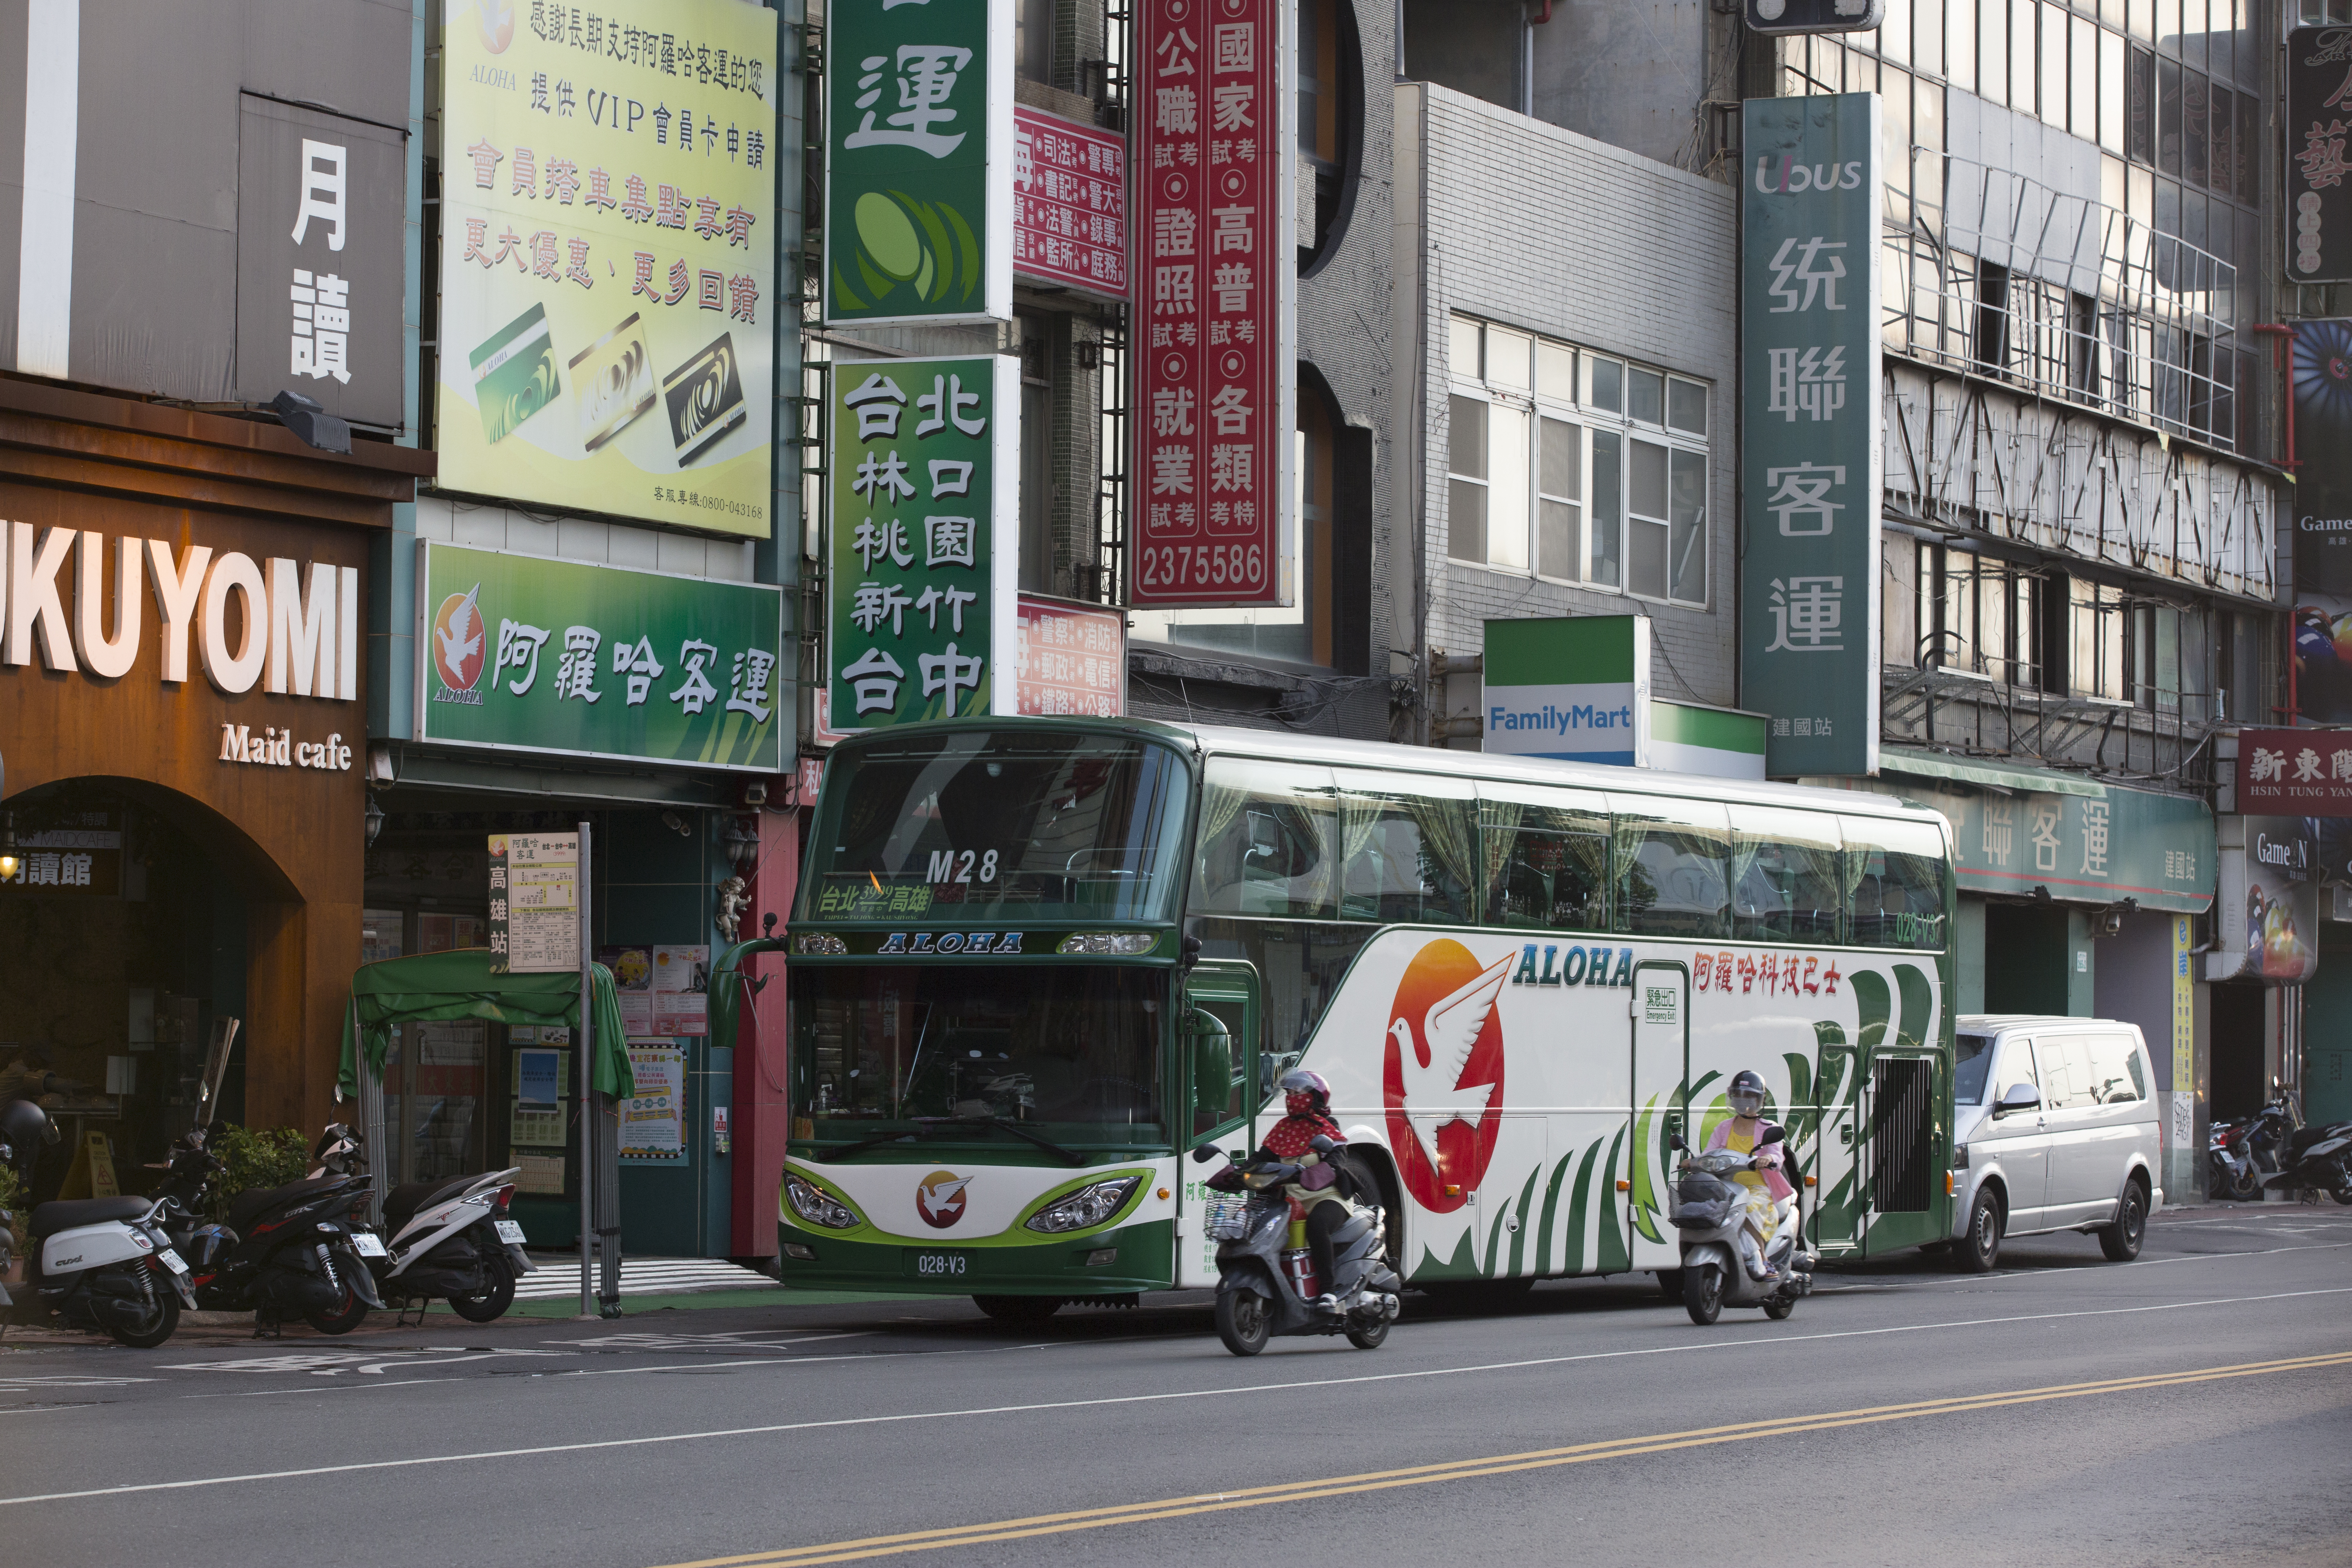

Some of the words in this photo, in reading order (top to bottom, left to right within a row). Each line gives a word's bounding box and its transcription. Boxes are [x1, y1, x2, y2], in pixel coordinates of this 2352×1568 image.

[530, 0, 763, 100] 感謝長期支持阿羅哈客運的您
[470, 65, 516, 91] ALOHA
[844, 0, 973, 158] 運
[531, 72, 575, 118] 提供
[587, 89, 644, 132] VIP
[653, 102, 765, 171] 會員卡申請
[467, 138, 755, 249] 會員搭車集點享有
[291, 138, 352, 385] 月讀
[487, 350, 508, 372] ALOHA
[639, 388, 654, 404] ALOHA
[729, 405, 745, 422] ALOHA
[844, 372, 987, 440] 台北
[1765, 236, 1847, 653] 統聯客運
[852, 450, 973, 506] 林口
[852, 516, 976, 572] 桃園
[1144, 544, 1261, 585] 2375586
[0, 519, 357, 701] KUYOMI
[851, 582, 977, 635] 新竹
[492, 618, 775, 724] 阿羅哈客運
[841, 642, 982, 718] 台中
[434, 686, 483, 706] ALOHA
[1491, 704, 1630, 735] FamilyMart
[1773, 717, 1833, 736] 建國站
[219, 722, 291, 766] Maid
[294, 733, 352, 771] cafe
[2250, 747, 2352, 783] 新東陽
[2250, 786, 2281, 796] HSIN
[2288, 787, 2323, 796] TUNG
[512, 838, 539, 848] 阿羅哈
[517, 850, 535, 860] 客運
[927, 849, 999, 884] M28
[2165, 850, 2195, 882] 建國站
[490, 866, 507, 954] 高雄站
[820, 885, 860, 912] 台北
[888, 885, 931, 912] 高雄
[860, 885, 893, 900] 3999
[878, 932, 1023, 954] ALOHA
[1896, 911, 1936, 944] 028-V3
[1512, 943, 1633, 987] ALOHA
[1693, 951, 1841, 997] 阿羅哈科技巴士
[1647, 989, 1675, 1007] 緊急出口
[1647, 1010, 1667, 1022] Emergency
[919, 1255, 966, 1274] 028-V3
